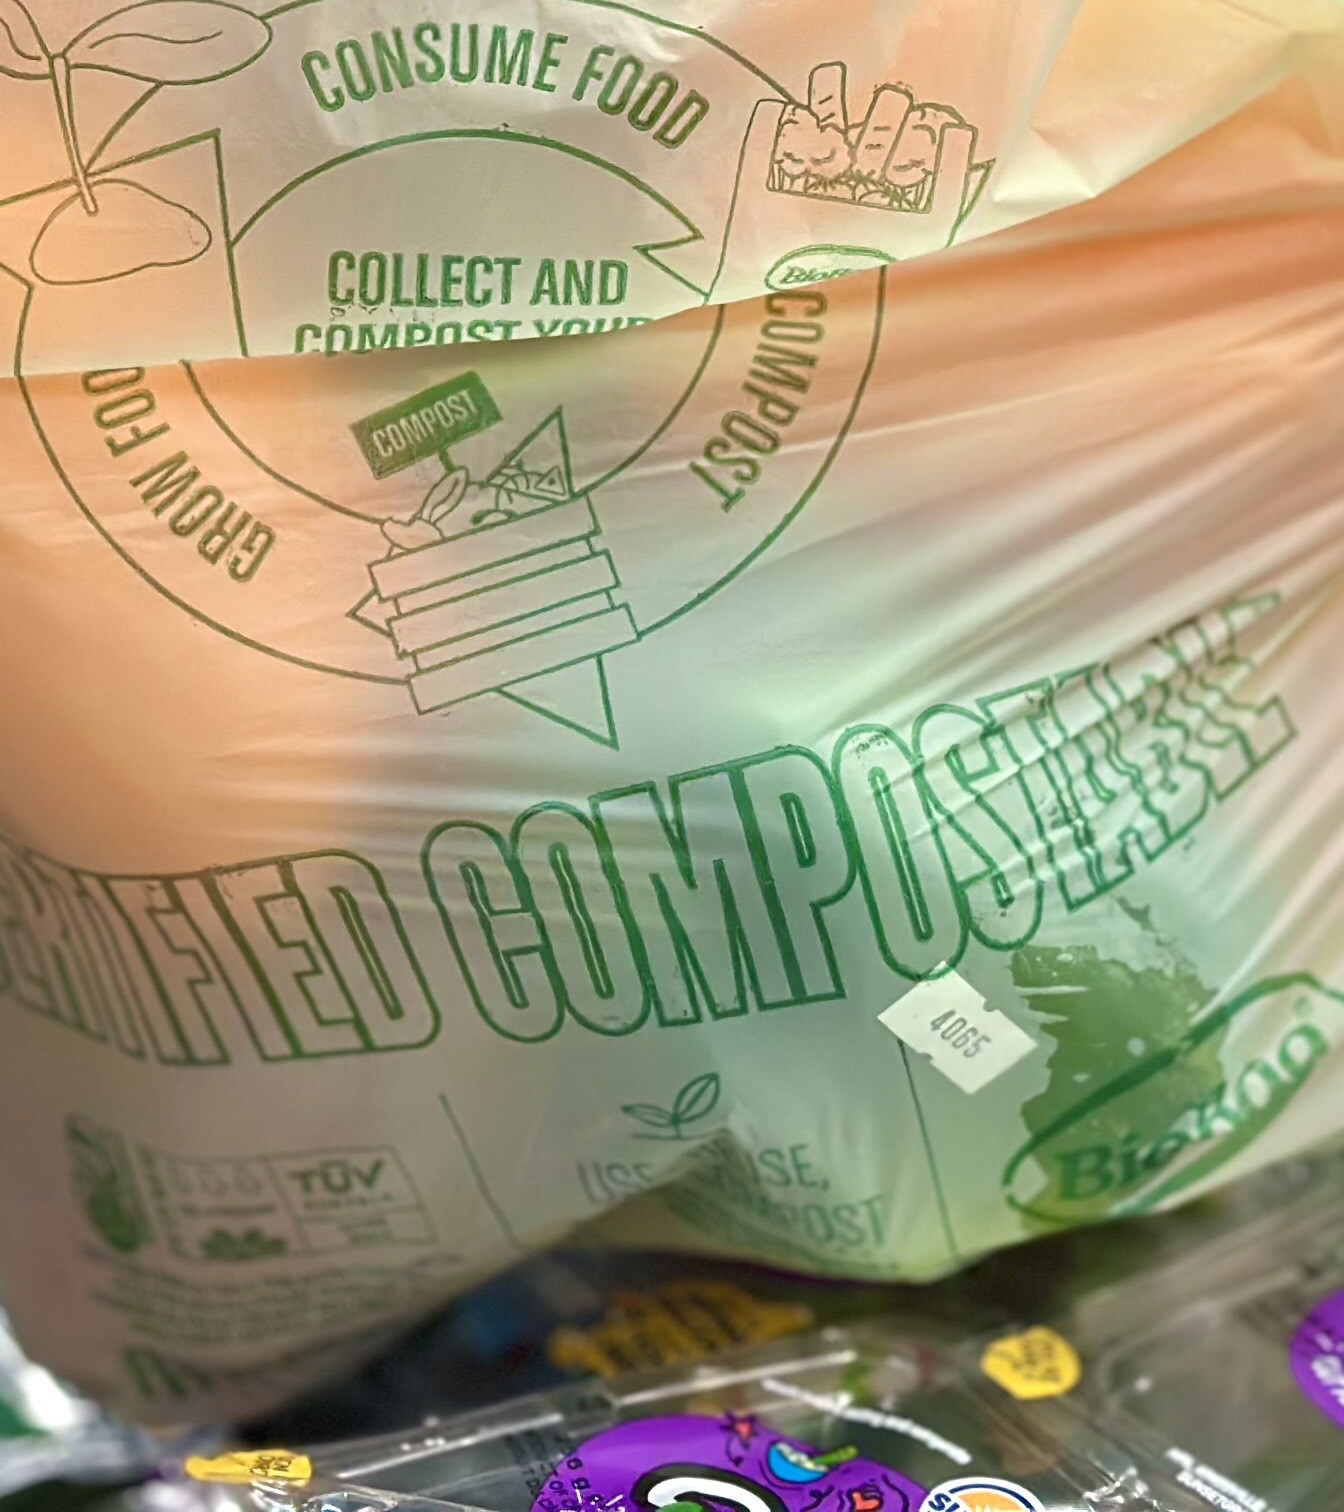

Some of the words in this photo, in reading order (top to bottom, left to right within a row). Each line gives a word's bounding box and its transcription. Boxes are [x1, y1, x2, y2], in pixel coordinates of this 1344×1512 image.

[301, 21, 568, 112] CONSUME
[571, 44, 710, 149] FOOD
[328, 250, 521, 307] COLLECT
[530, 258, 629, 306] AND
[81, 366, 170, 458] FOO
[372, 389, 479, 457] COMPOST
[689, 290, 827, 513] COMPOST
[129, 450, 277, 583] GROW
[930, 1008, 993, 1058] 4065
[286, 1158, 386, 1196] TÜV
